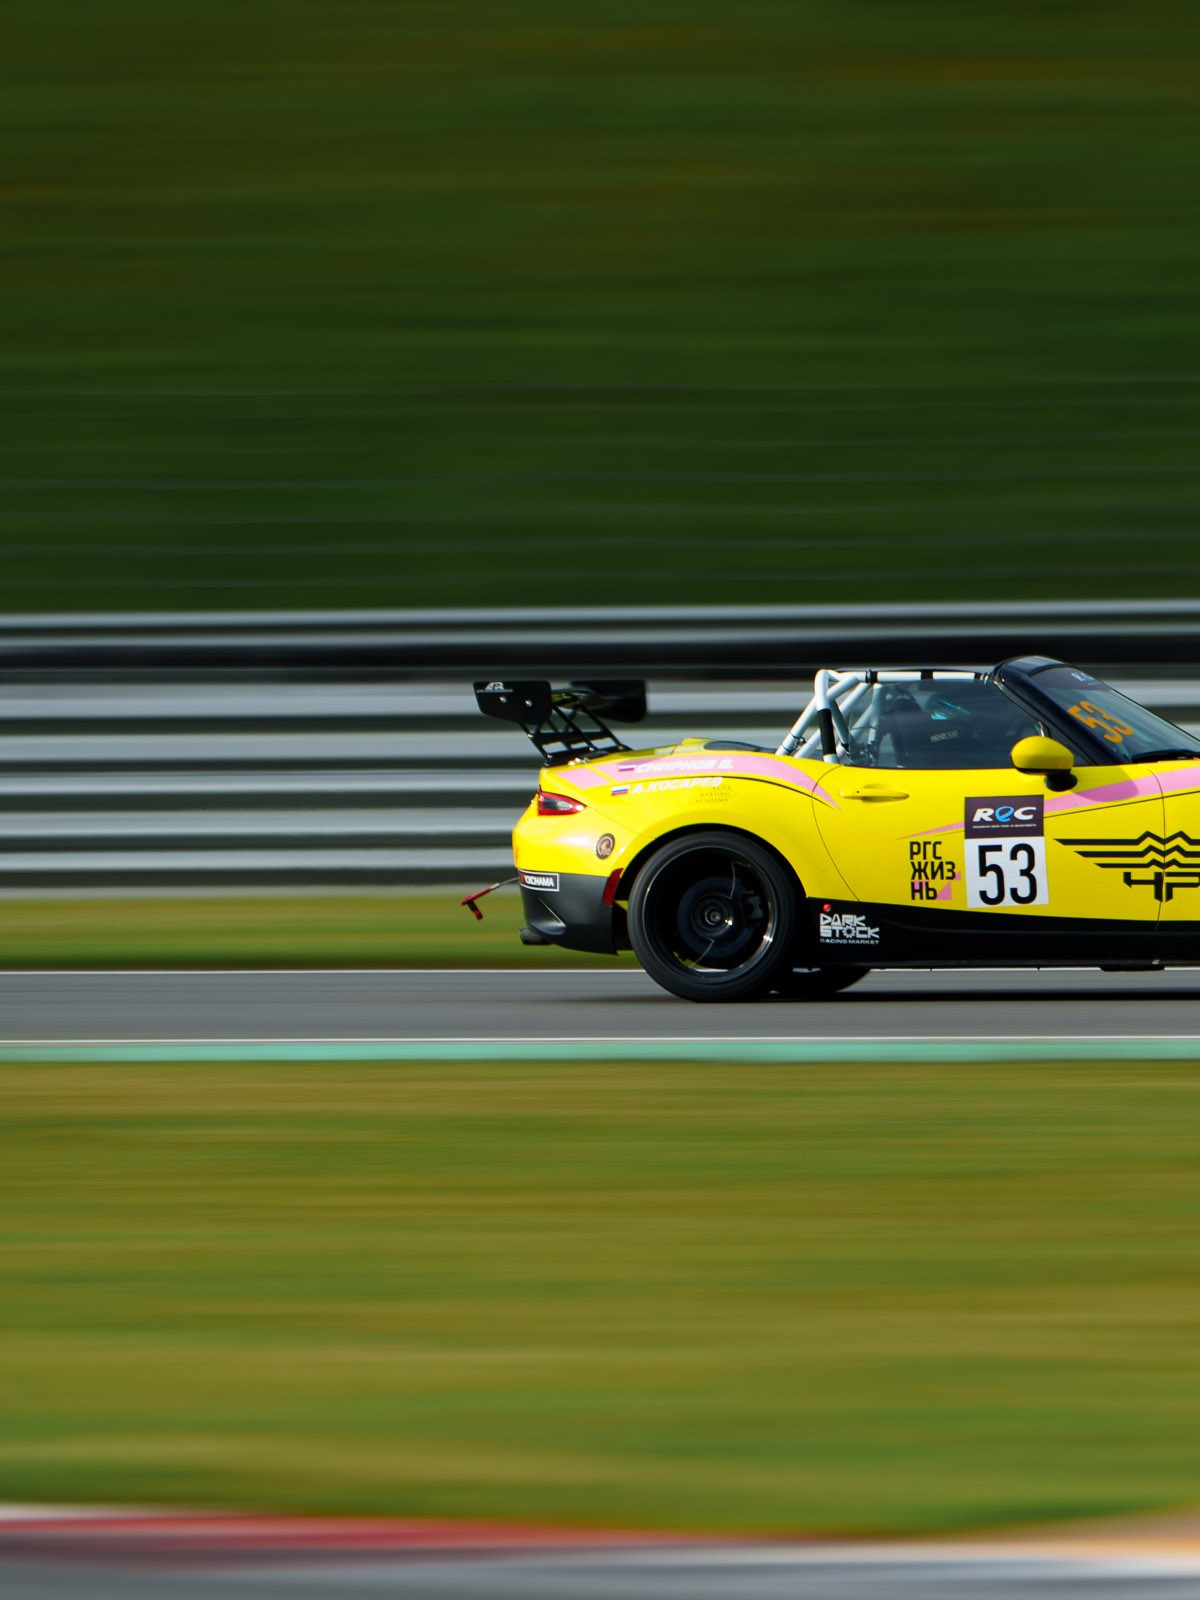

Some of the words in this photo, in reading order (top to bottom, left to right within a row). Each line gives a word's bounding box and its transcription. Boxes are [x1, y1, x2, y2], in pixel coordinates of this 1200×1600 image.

[1067, 700, 1134, 744] 53
[909, 841, 943, 860] РГС
[910, 861, 956, 881] ЖИЗ
[978, 843, 1038, 906] 53
[820, 913, 866, 926] DARK
[820, 925, 880, 939] STOCK
